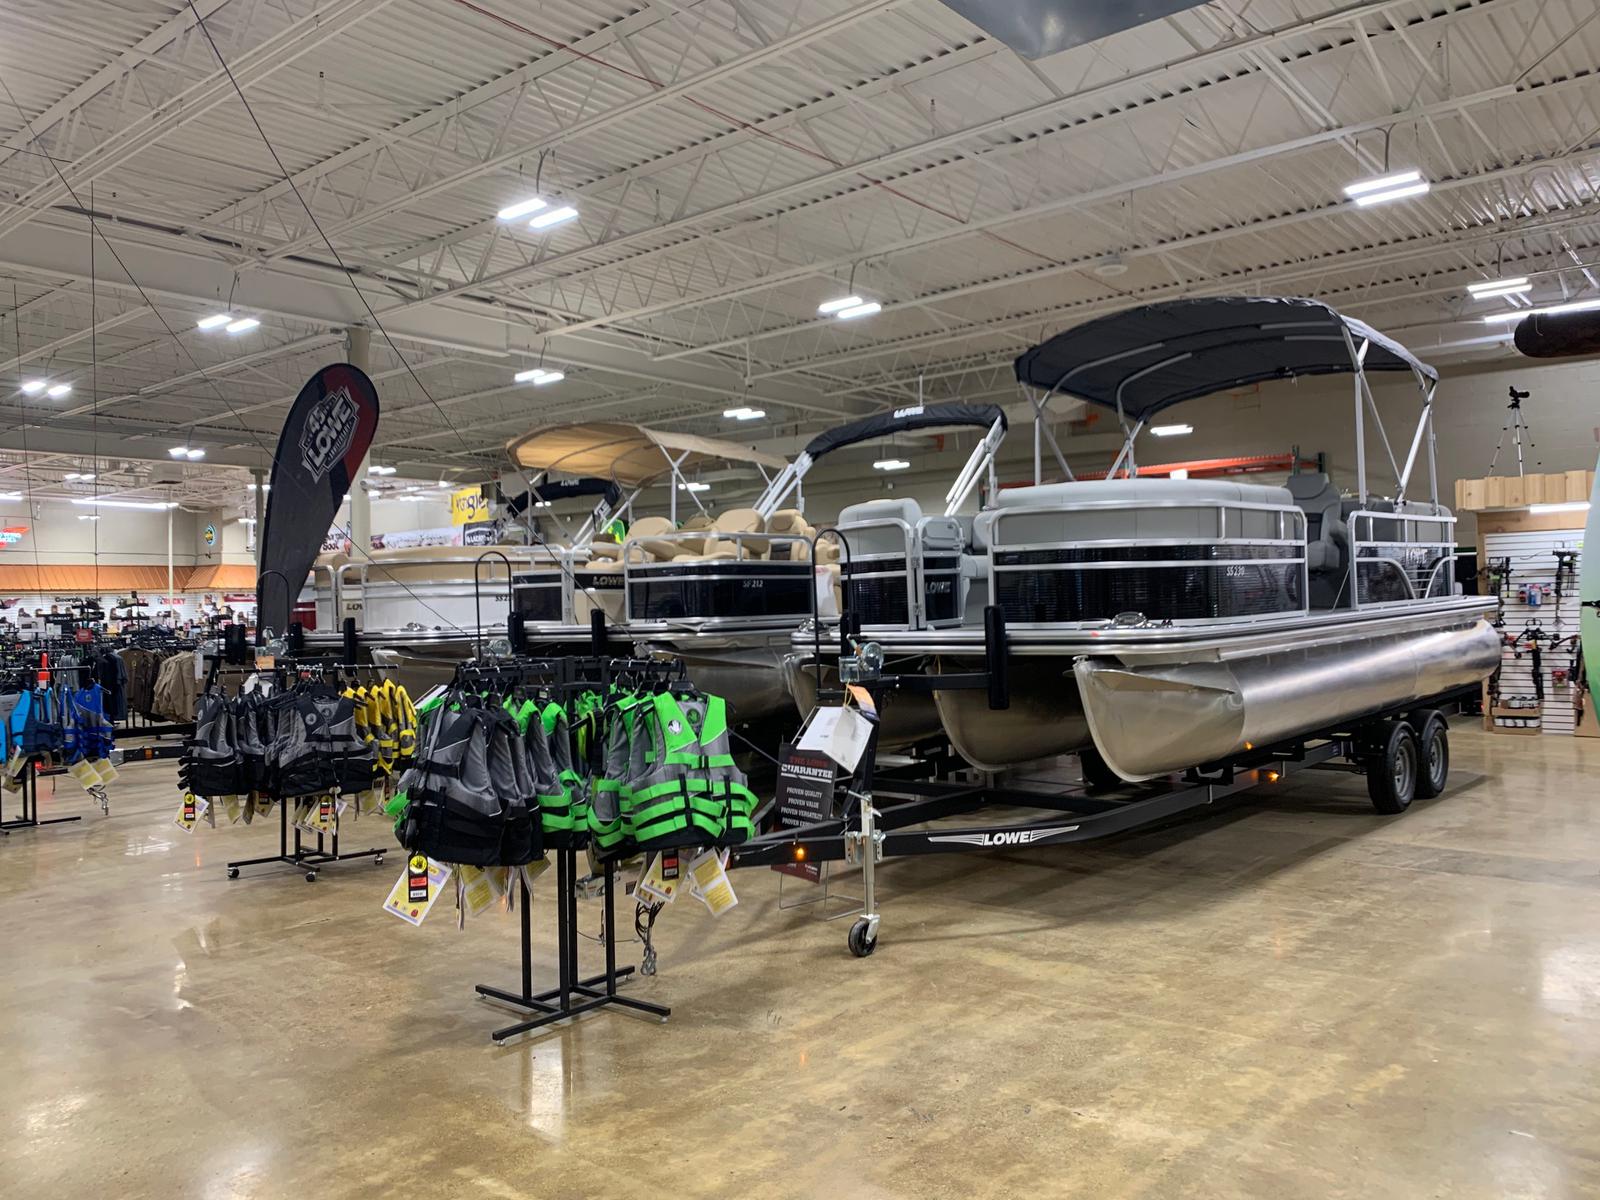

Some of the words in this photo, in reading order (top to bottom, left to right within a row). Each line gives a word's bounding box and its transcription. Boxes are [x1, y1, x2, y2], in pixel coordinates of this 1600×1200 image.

[307, 397, 352, 467] LOWE
[925, 581, 951, 594] LOWE
[781, 763, 833, 779] GUARANTEE
[786, 787, 804, 796] PROVEN
[804, 790, 822, 799] QUALITY
[787, 797, 805, 806] PROVEN
[806, 800, 819, 809] VALUE
[781, 806, 798, 816] PROVEN
[798, 809, 823, 820] VERSATILITY
[782, 817, 799, 826] PROVEN
[983, 831, 1031, 846] LOWE
